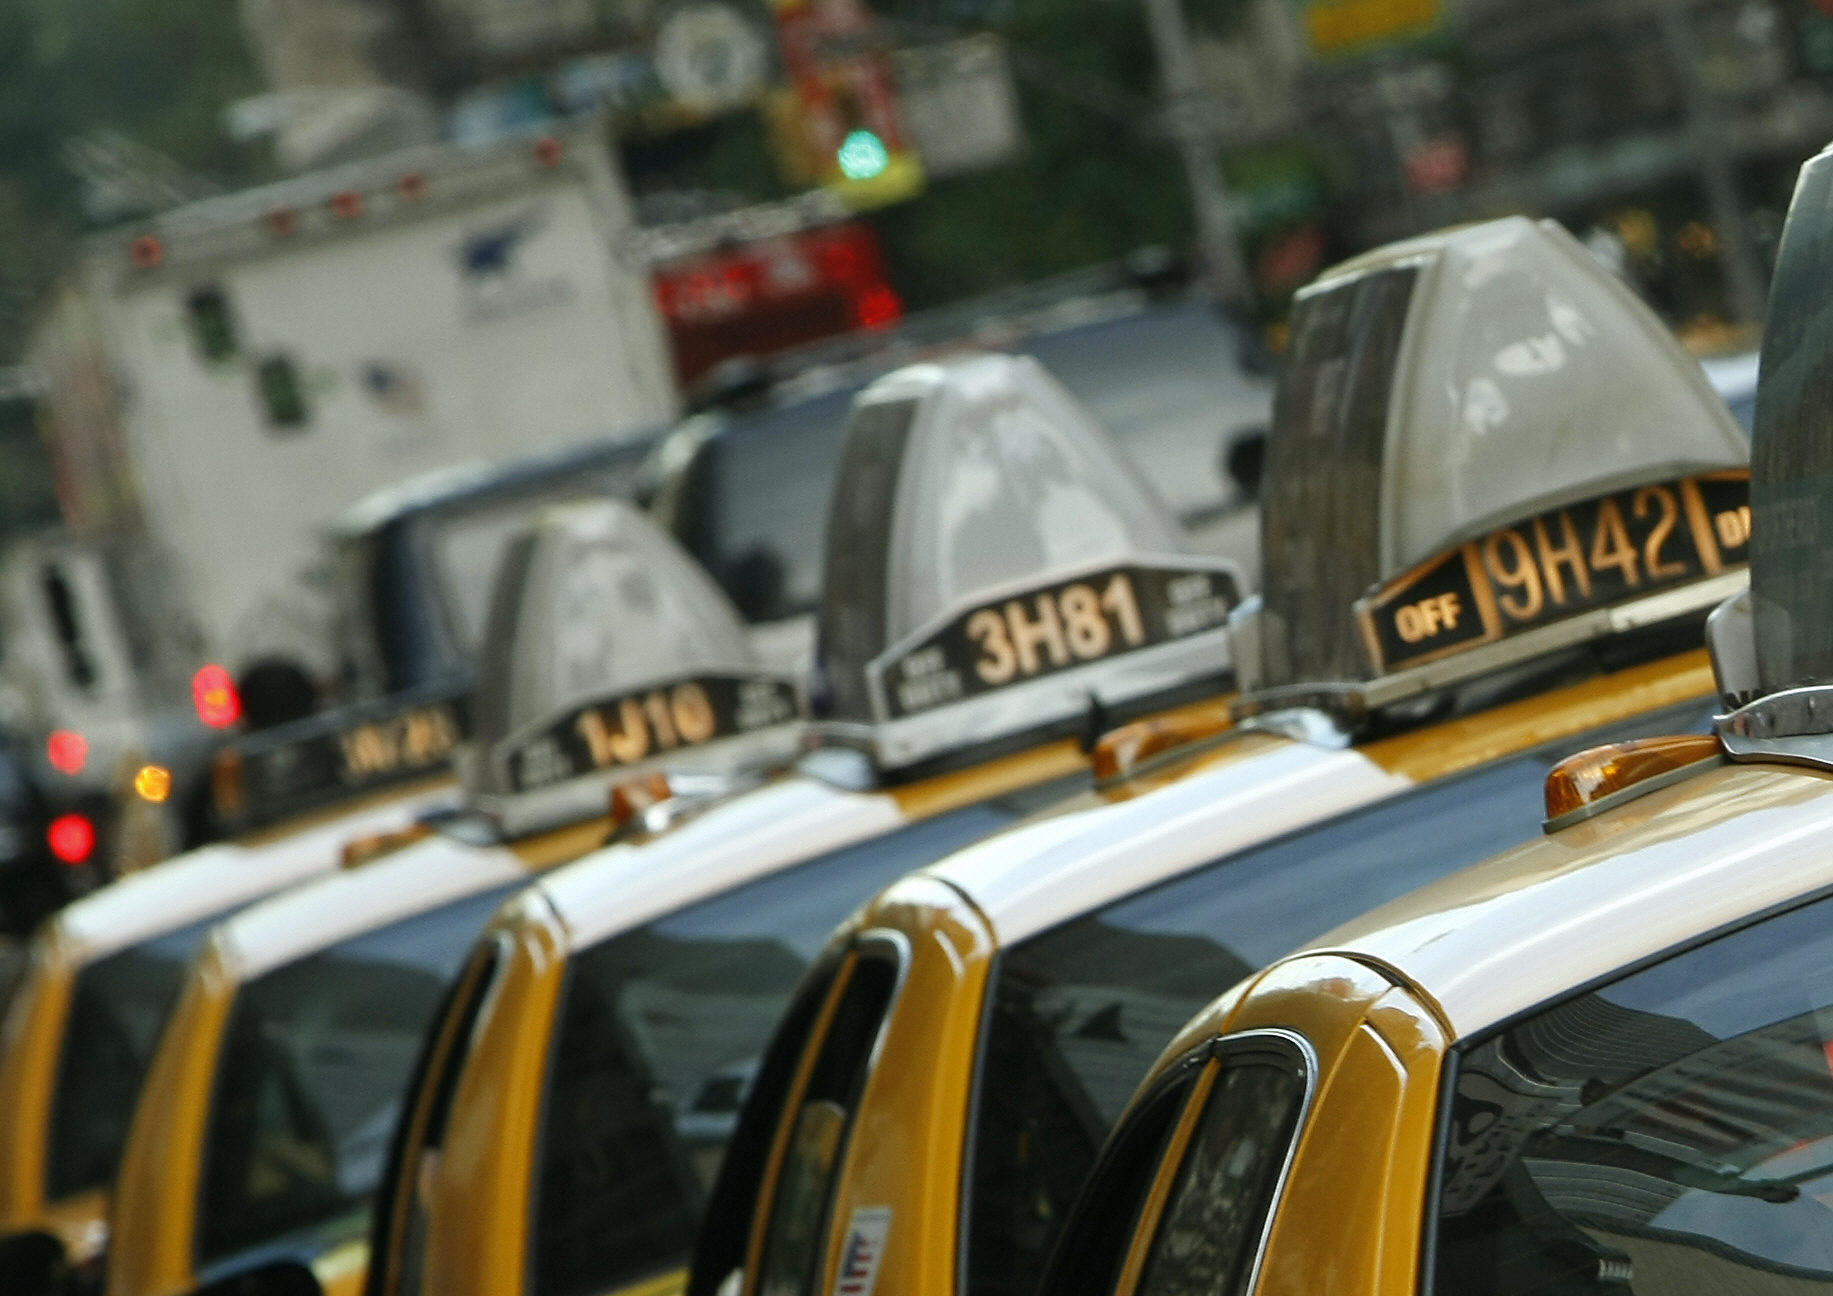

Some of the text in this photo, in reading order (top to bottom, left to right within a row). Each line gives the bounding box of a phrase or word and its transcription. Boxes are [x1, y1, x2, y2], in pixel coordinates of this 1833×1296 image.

[1482, 485, 1687, 621] 9H42
[966, 573, 1145, 685] 3H81
[1394, 592, 1463, 643] OFF
[577, 682, 717, 766] 1J10
